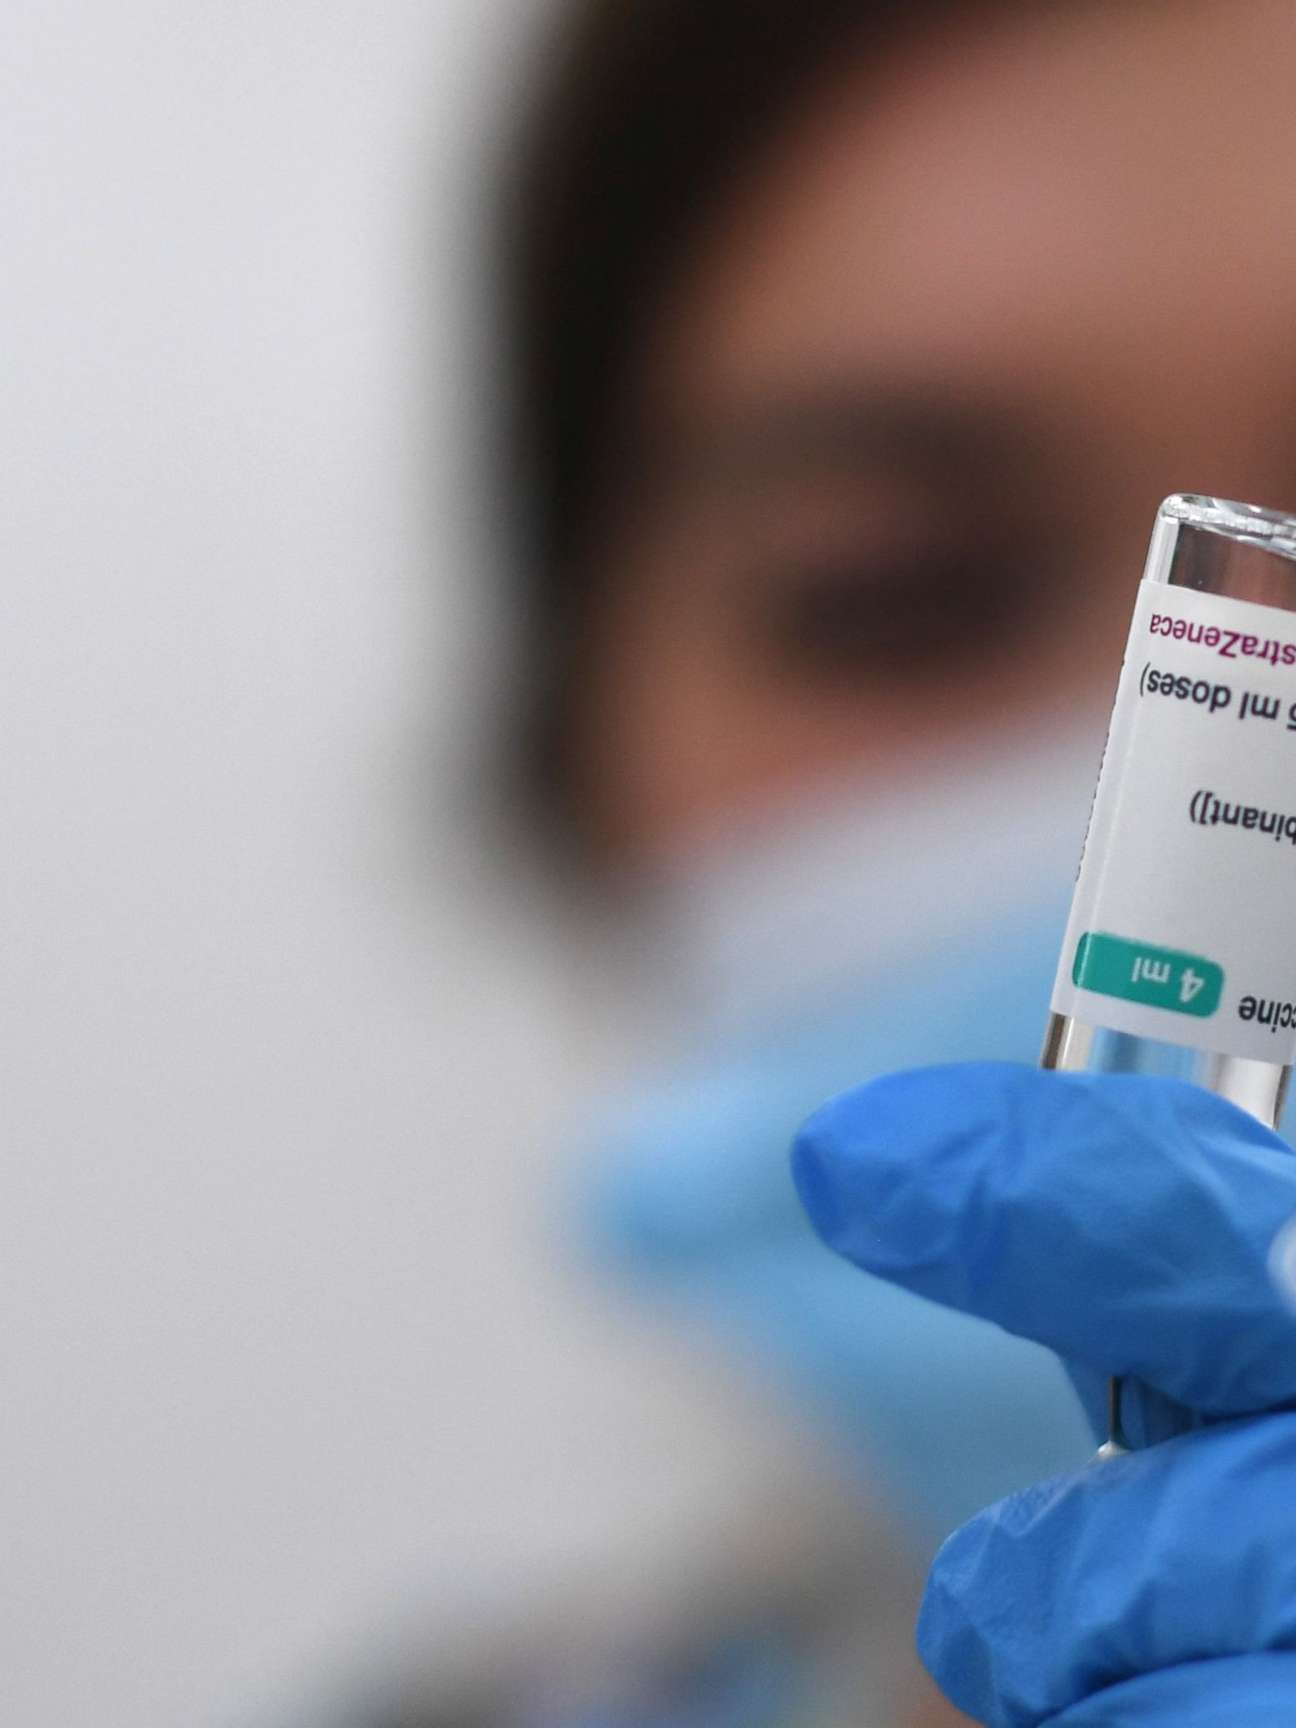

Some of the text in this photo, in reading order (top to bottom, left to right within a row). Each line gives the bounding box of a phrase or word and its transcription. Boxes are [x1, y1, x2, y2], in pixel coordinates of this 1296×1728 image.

[1140, 662, 1232, 712] doses)
[1239, 692, 1280, 721] ml
[1131, 956, 1205, 1003] 4 ml
